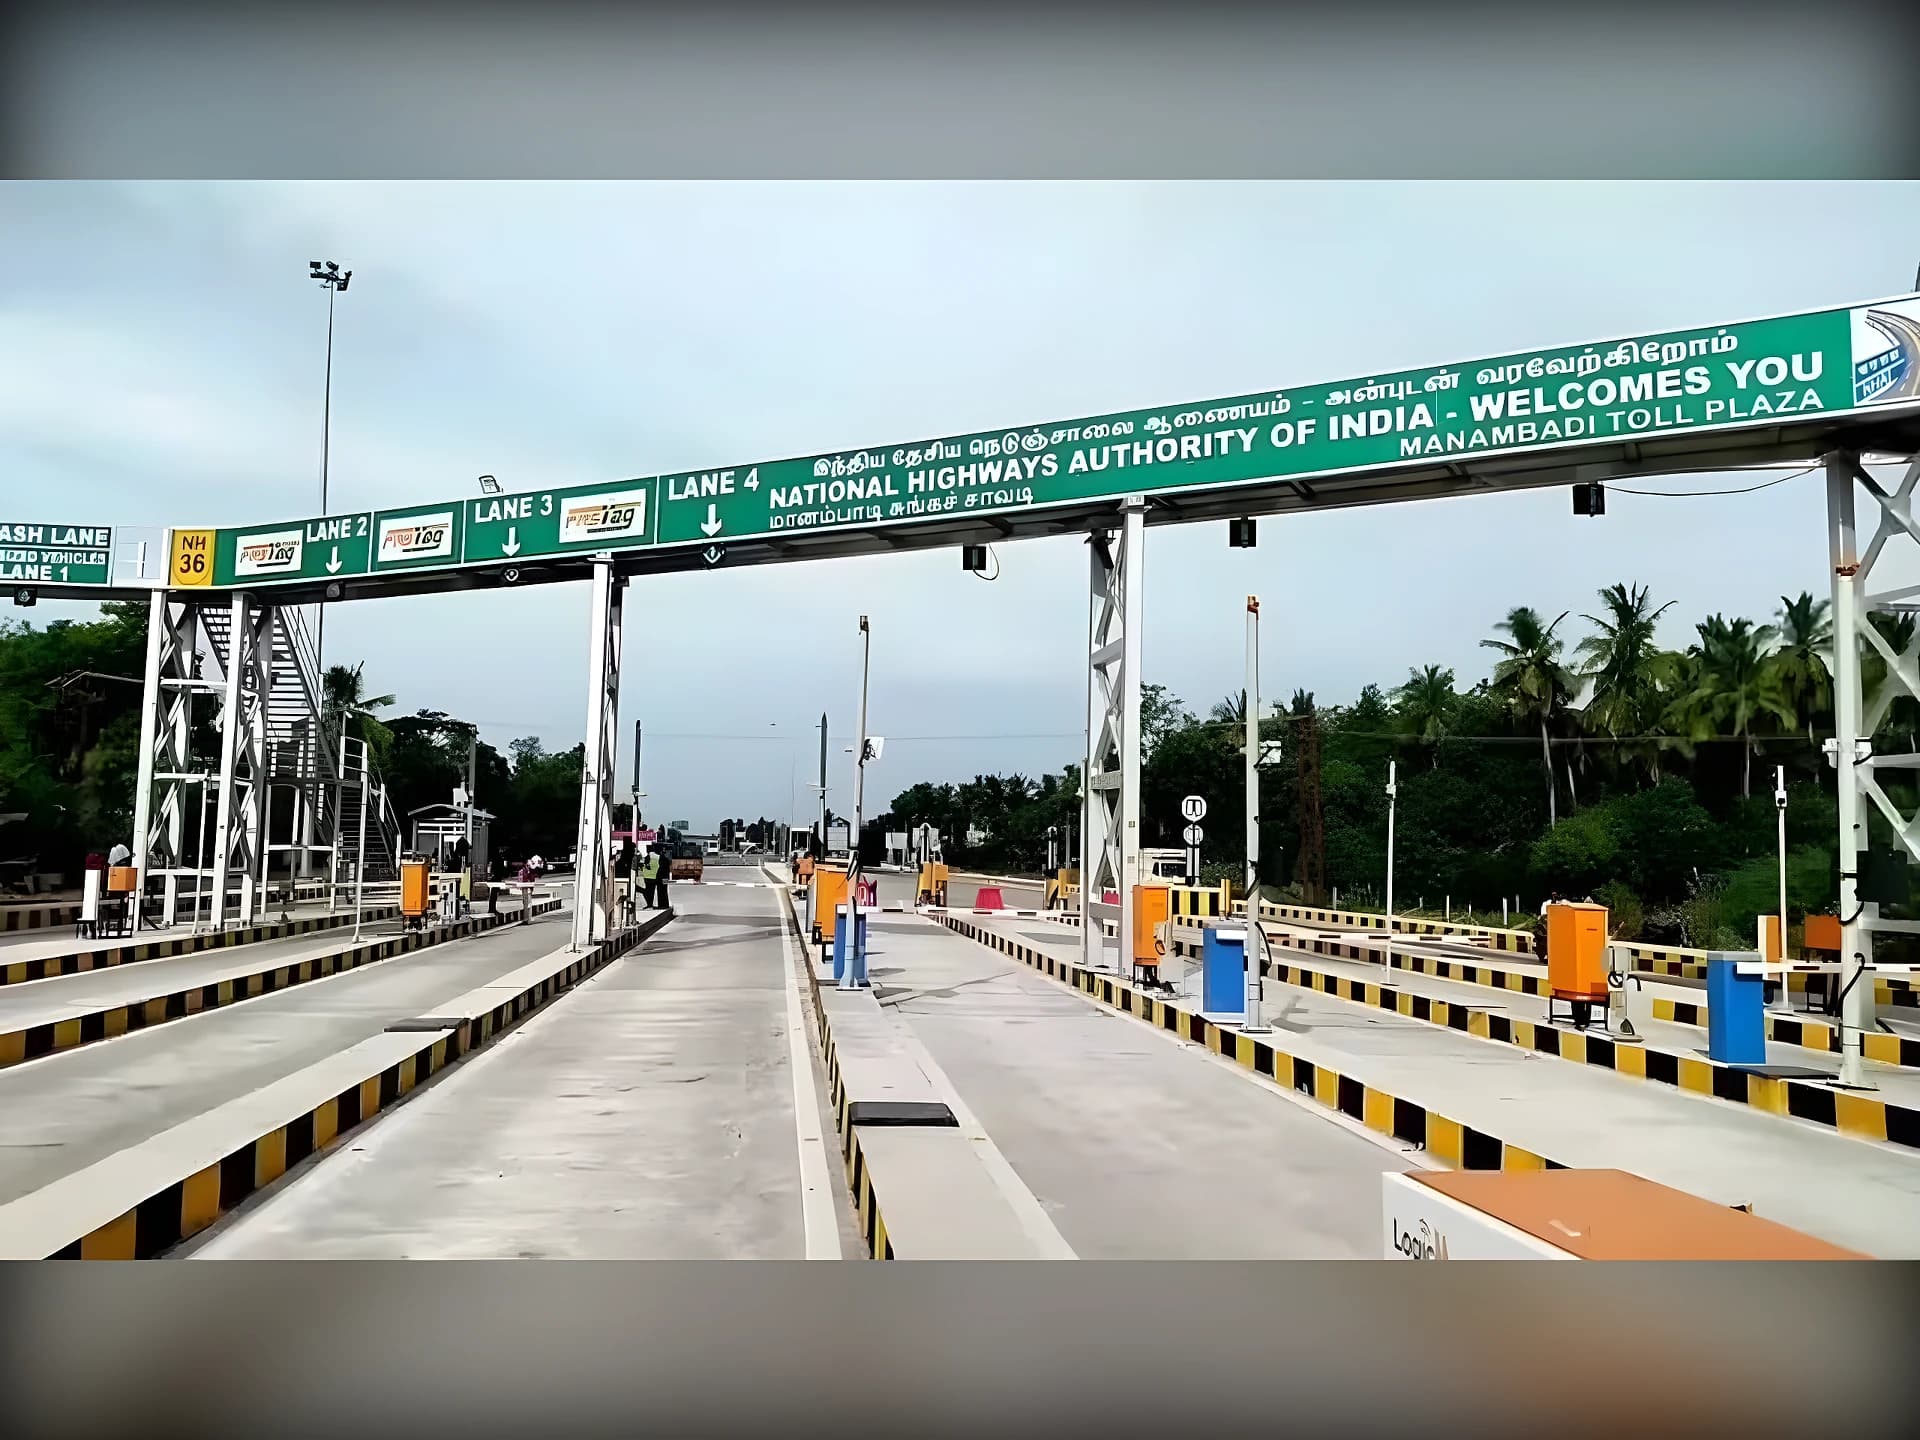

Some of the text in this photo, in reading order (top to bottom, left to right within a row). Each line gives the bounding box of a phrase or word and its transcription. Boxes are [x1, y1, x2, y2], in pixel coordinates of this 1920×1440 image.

[814, 451, 885, 477] இந்திய
[892, 441, 961, 469] தேசிய
[969, 421, 1134, 458] நெடுஞ்சாலை
[1143, 394, 1291, 435] ஆணையம்
[1325, 369, 1460, 406] அன்புடன்
[1476, 329, 1739, 385] வரவேற்கிறோம்
[769, 475, 898, 509] NATIONAL
[907, 453, 1059, 494] HIGHWAYS
[1068, 427, 1258, 474] AUTHORITY
[1270, 419, 1316, 448] OF
[1329, 403, 1434, 440] INDIA
[1470, 365, 1712, 421] WELCOMES
[1725, 351, 1823, 390] YOU
[1400, 388, 1825, 457] MANAMBADI TOLL PLAZA
[668, 467, 760, 500] LANE 4
[474, 495, 553, 523] LANE 3
[769, 504, 883, 529] மானம்பாடி
[964, 486, 1034, 508] சாவடி
[50, 527, 109, 546] LANE
[182, 535, 206, 550] NH
[306, 516, 368, 543] LANE 2
[0, 563, 69, 582] LANE 1
[180, 553, 205, 574] 36
